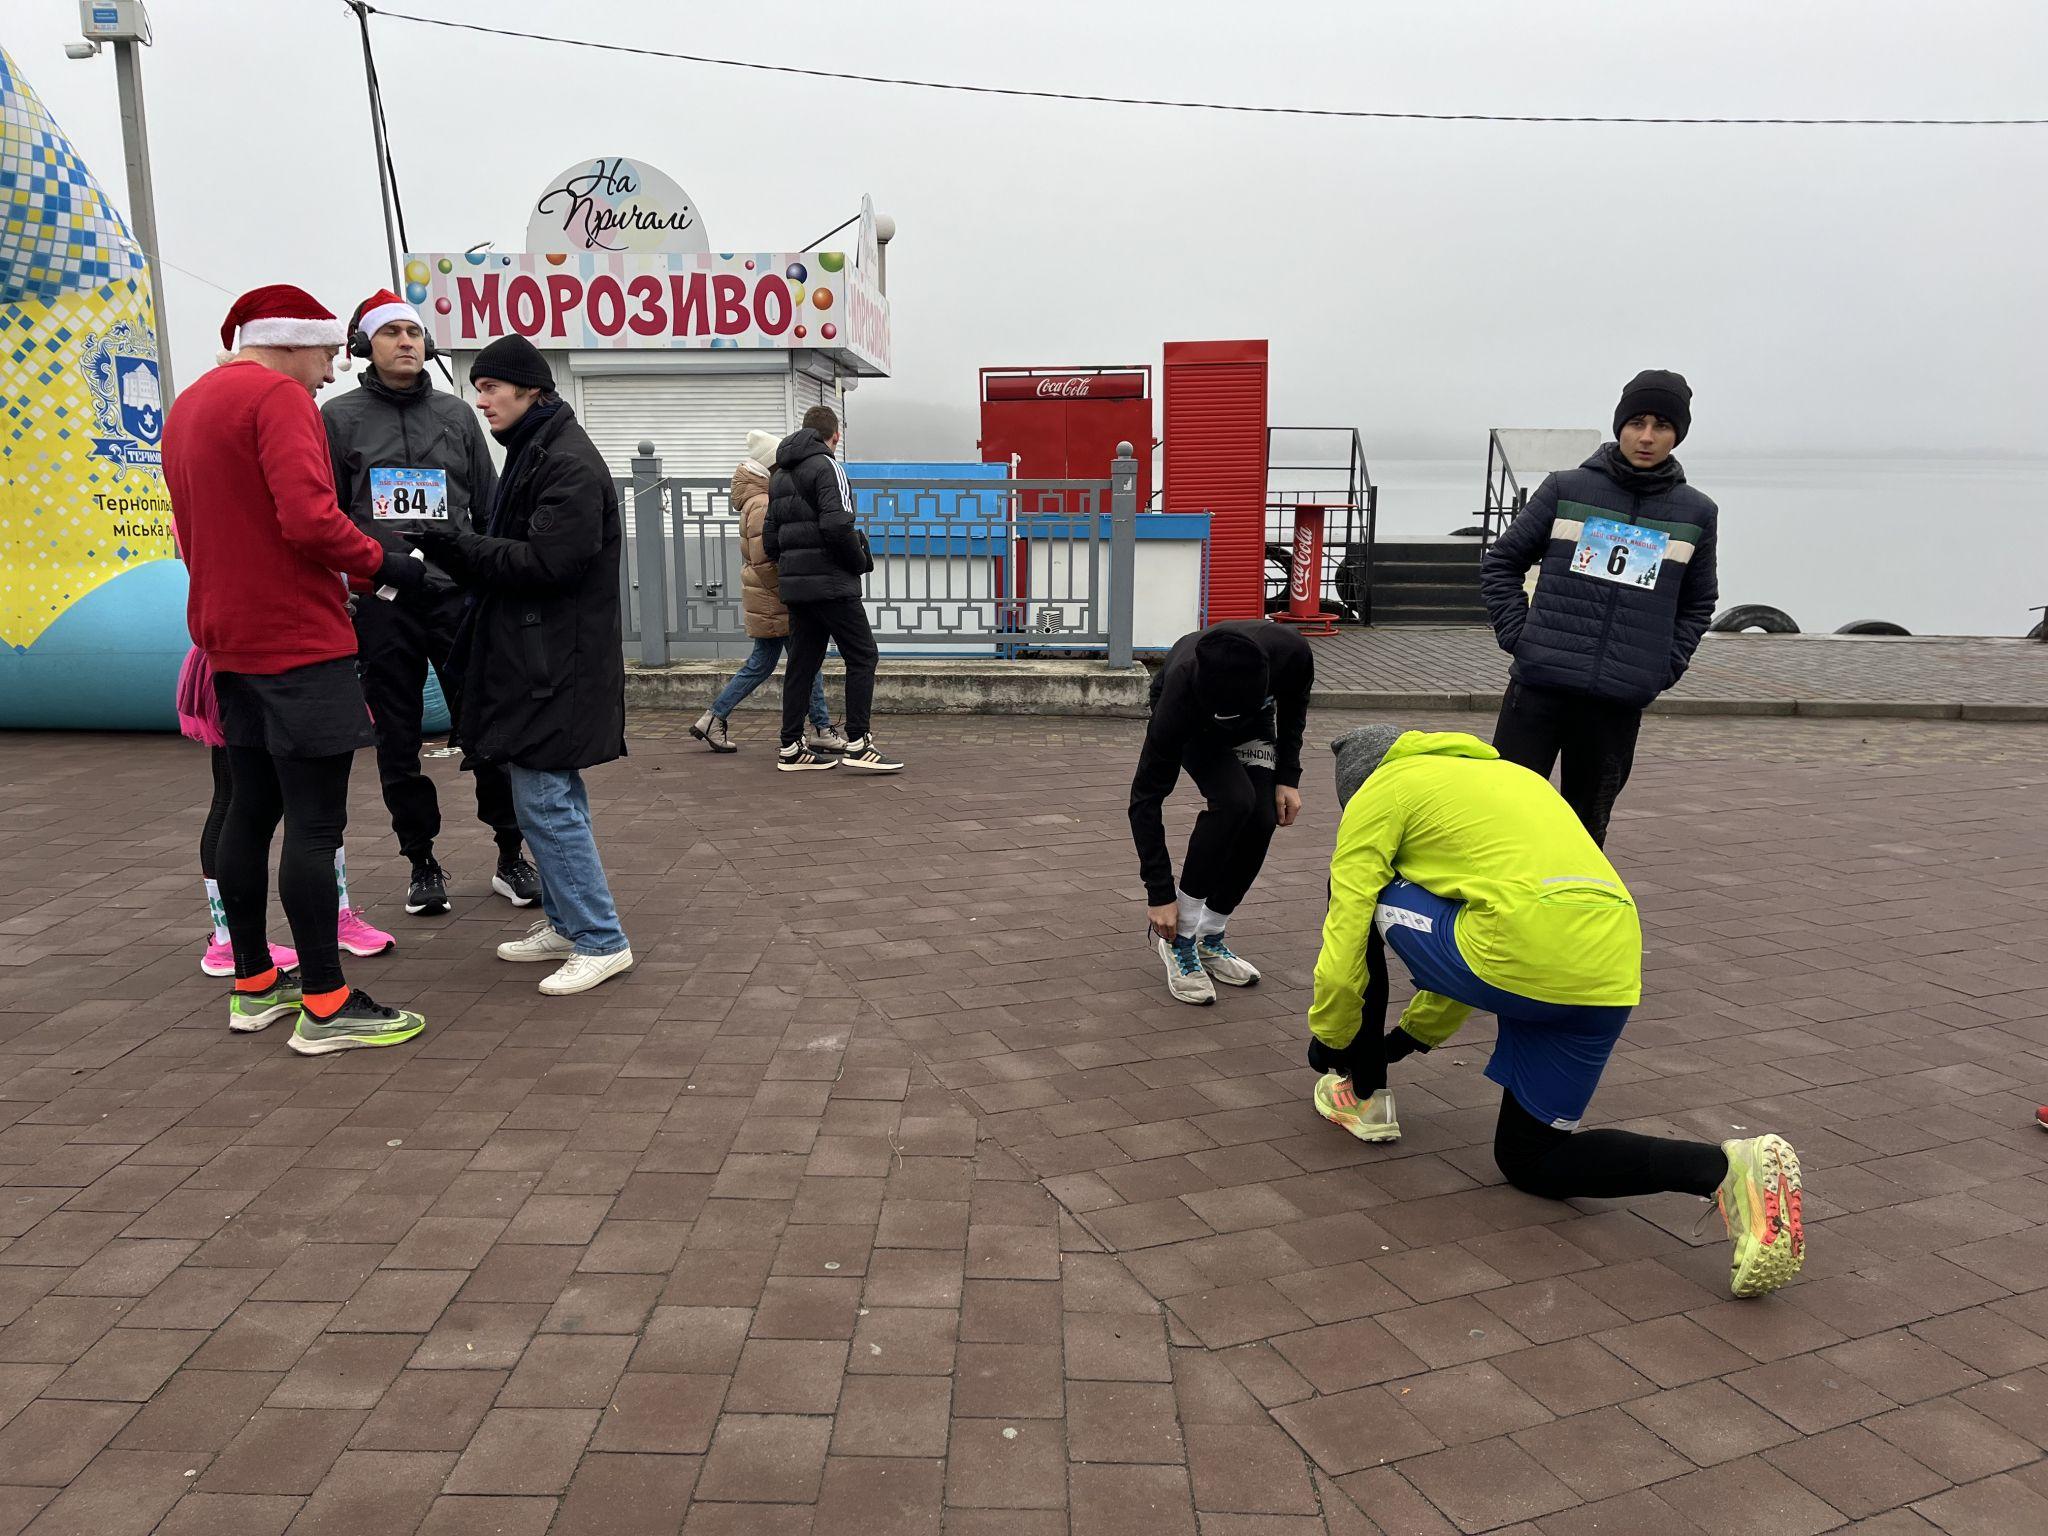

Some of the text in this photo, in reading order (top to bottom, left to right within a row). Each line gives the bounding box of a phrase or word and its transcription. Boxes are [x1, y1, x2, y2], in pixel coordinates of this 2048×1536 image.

[566, 158, 637, 198] На
[456, 272, 793, 339] МОРОЗИВО
[1036, 378, 1092, 396] Coca-Cola
[393, 487, 428, 514] 84
[113, 520, 164, 537] міська
[1607, 544, 1630, 576] 6
